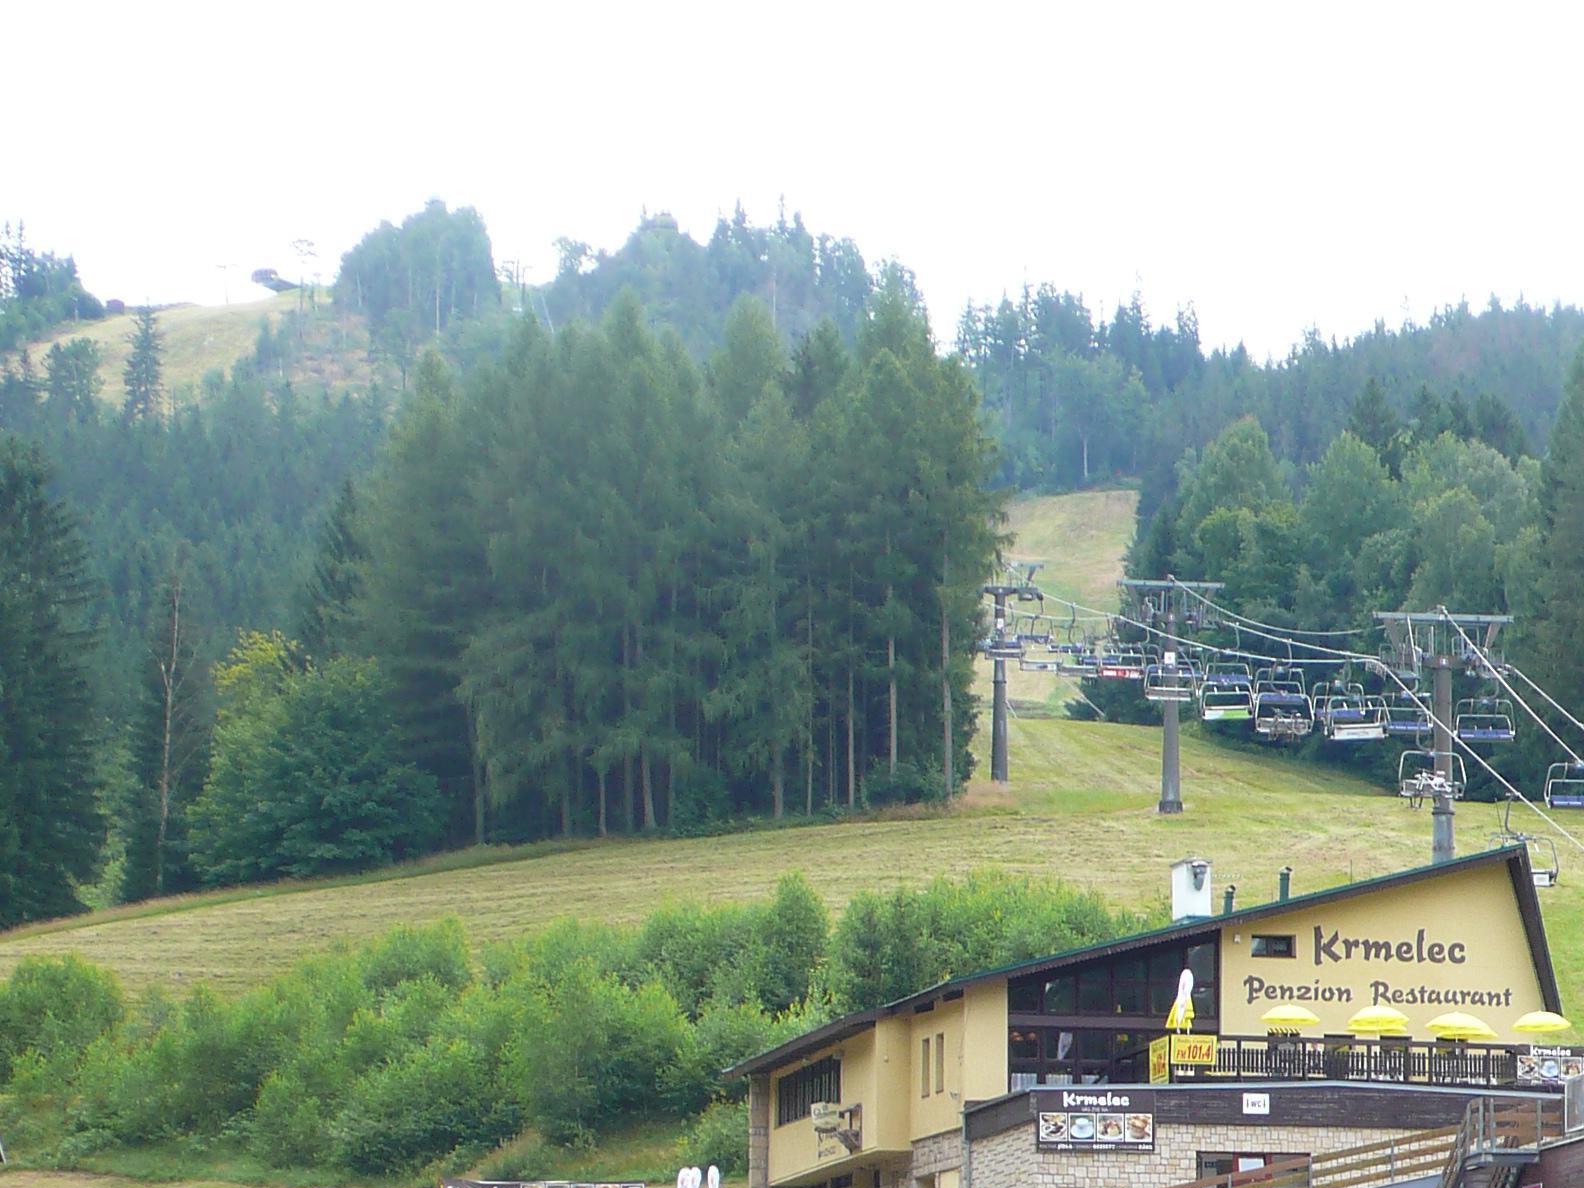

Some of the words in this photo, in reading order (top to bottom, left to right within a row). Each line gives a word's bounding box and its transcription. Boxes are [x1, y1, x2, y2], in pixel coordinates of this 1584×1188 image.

[1313, 925, 1466, 966] Krmelec
[1243, 975, 1353, 1005] Penzion
[1370, 980, 1512, 1006] Restaurant
[1530, 1045, 1571, 1057] Krmelec
[1063, 1091, 1130, 1108] Krmelec
